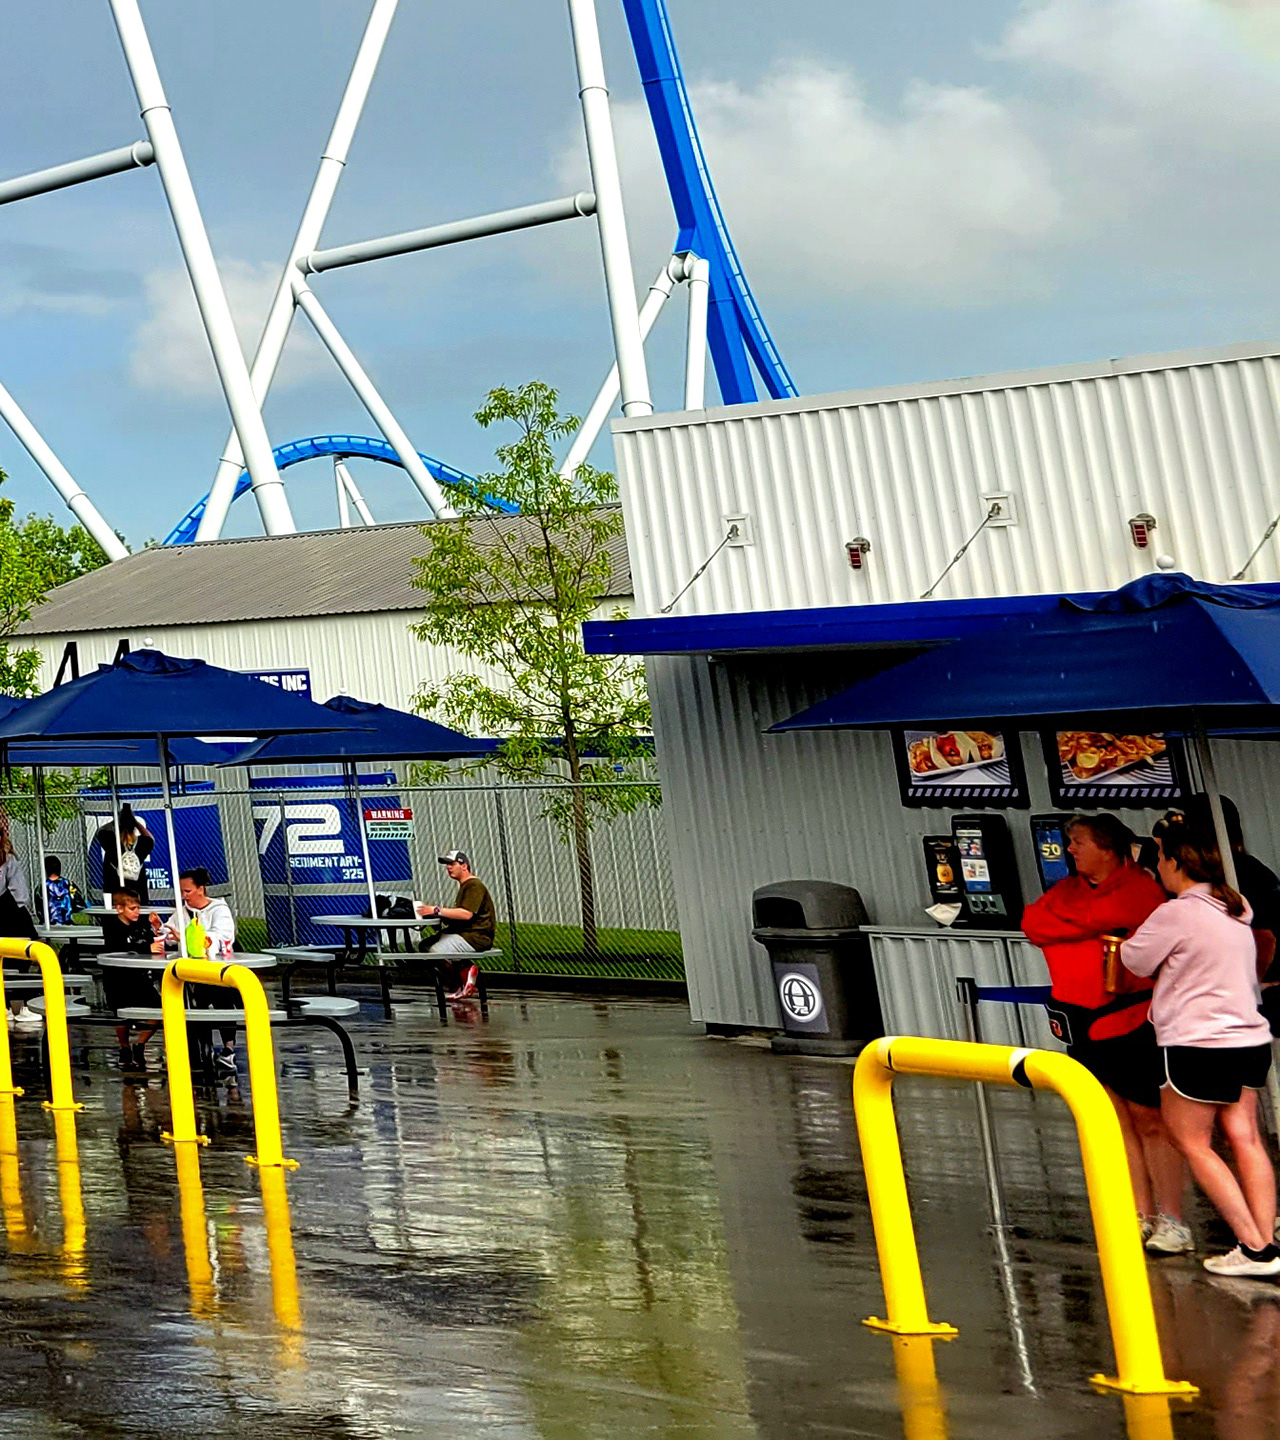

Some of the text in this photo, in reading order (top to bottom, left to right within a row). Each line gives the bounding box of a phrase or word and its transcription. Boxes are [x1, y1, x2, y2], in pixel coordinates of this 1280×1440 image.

[281, 675, 307, 691] INC
[370, 810, 405, 819] WARNING
[252, 803, 345, 855] 72
[1041, 843, 1061, 856] 50
[289, 855, 363, 869] SEDIMENTARY-
[342, 868, 364, 880] 325
